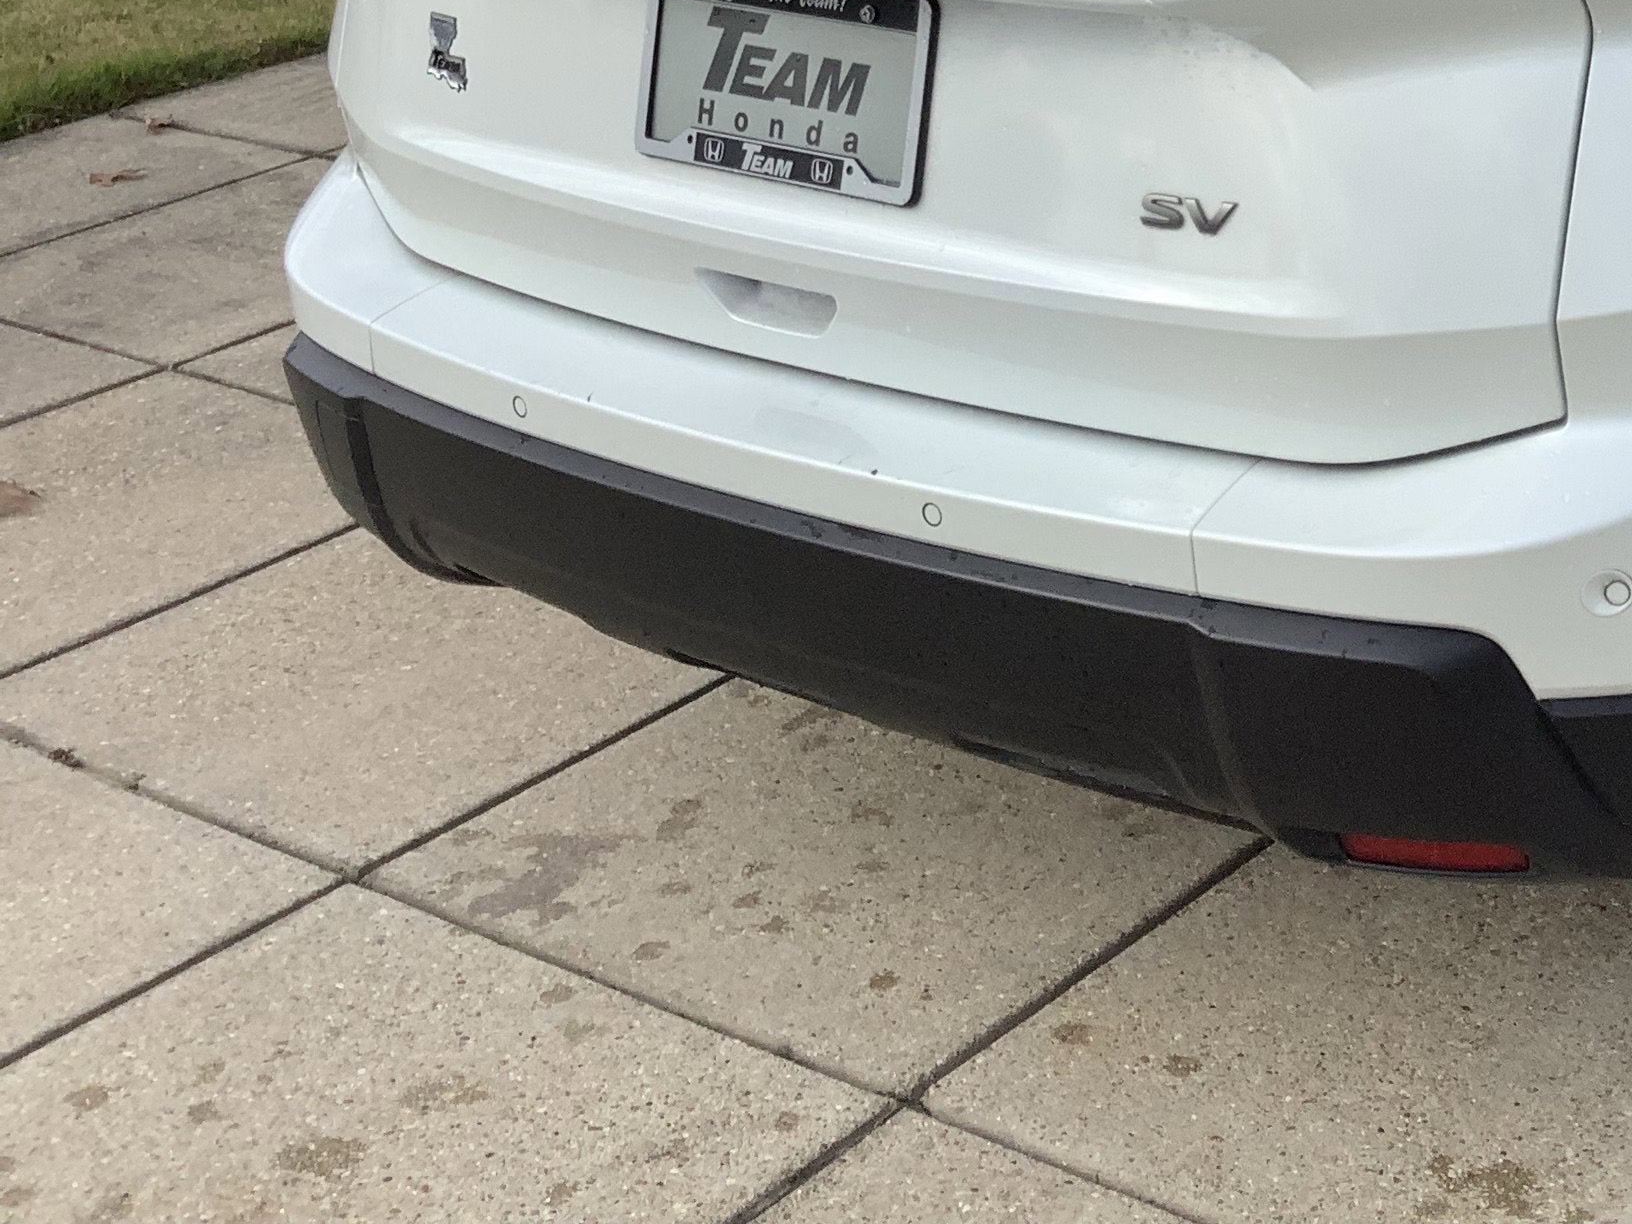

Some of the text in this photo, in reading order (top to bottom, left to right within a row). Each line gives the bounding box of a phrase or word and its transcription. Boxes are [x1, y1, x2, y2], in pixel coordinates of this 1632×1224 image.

[702, 5, 872, 117] TEAM
[697, 97, 860, 154] Honda
[740, 142, 794, 179] TEAM
[1140, 192, 1239, 236] SV
